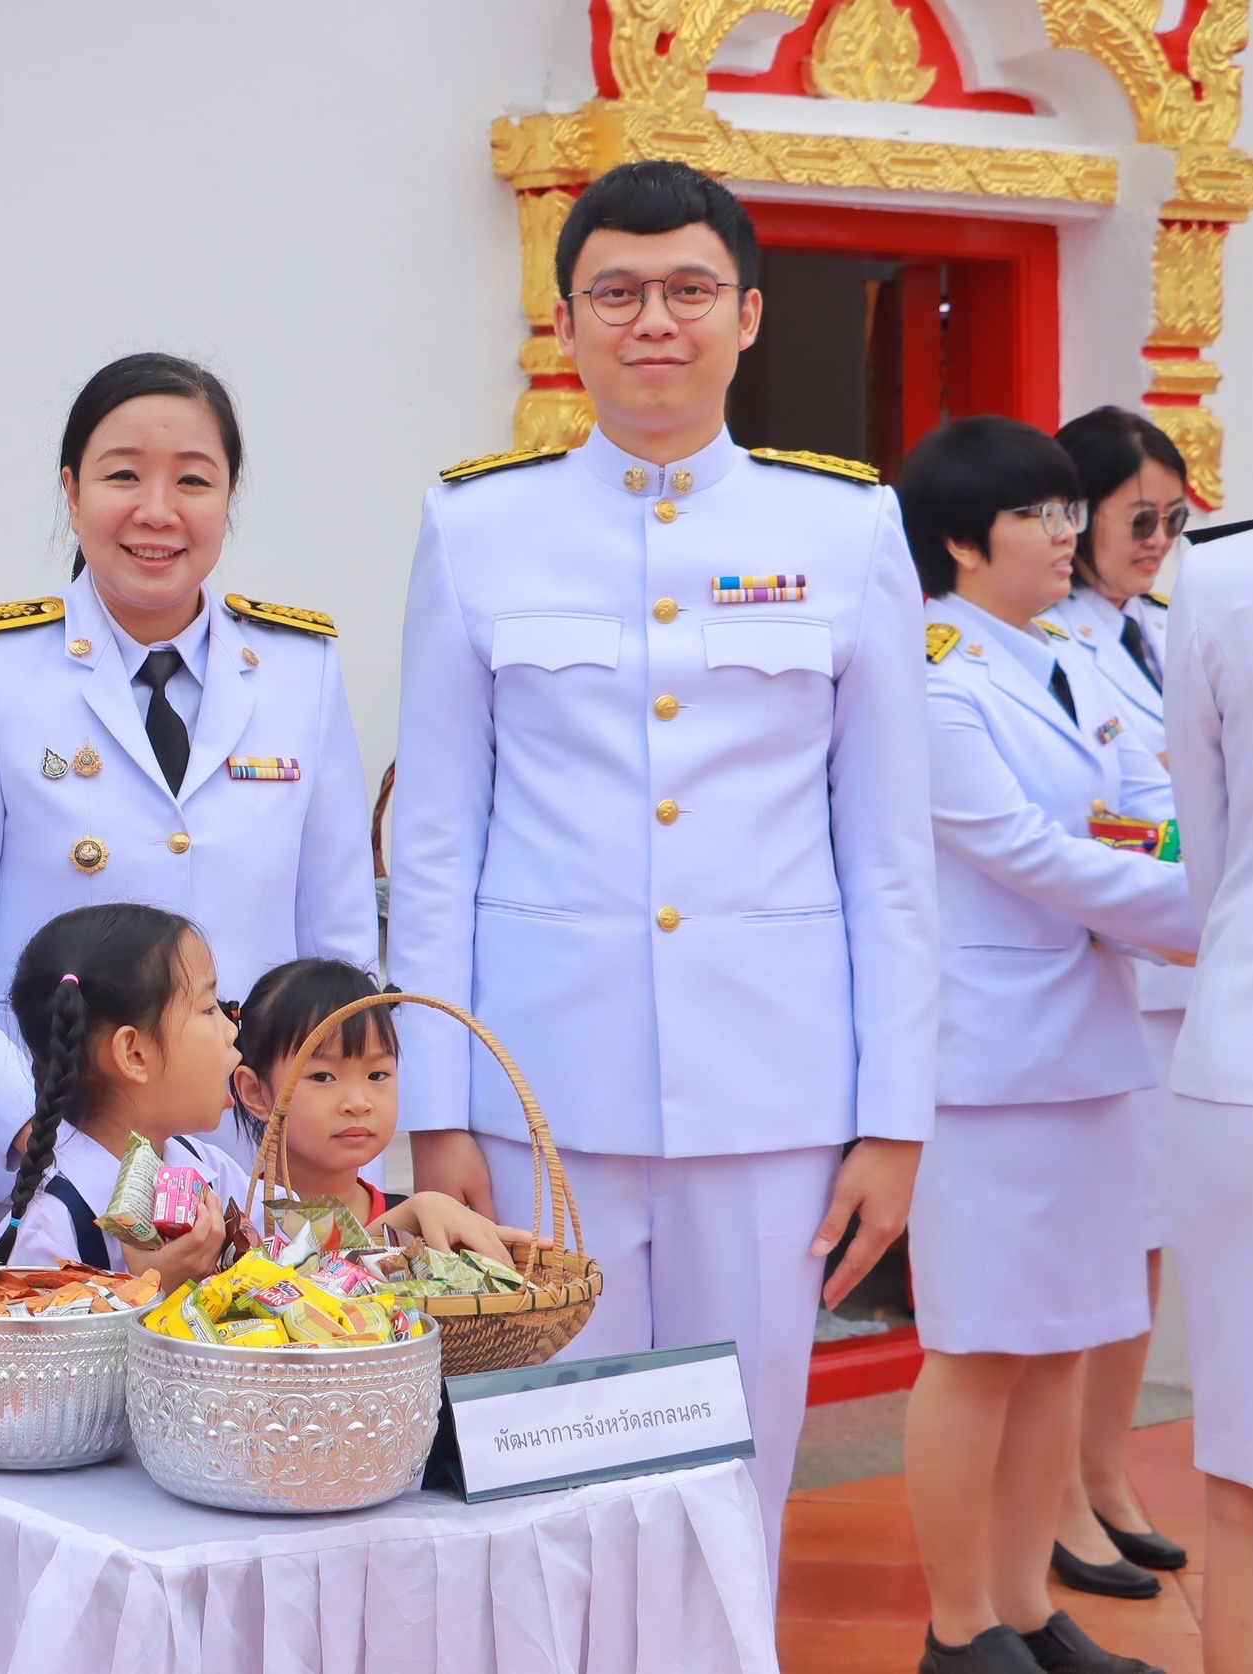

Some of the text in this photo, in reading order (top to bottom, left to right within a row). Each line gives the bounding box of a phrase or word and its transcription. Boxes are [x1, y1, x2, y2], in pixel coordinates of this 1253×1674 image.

[493, 1402, 712, 1453] พัฒนาการจังหวัดสกลนคร
